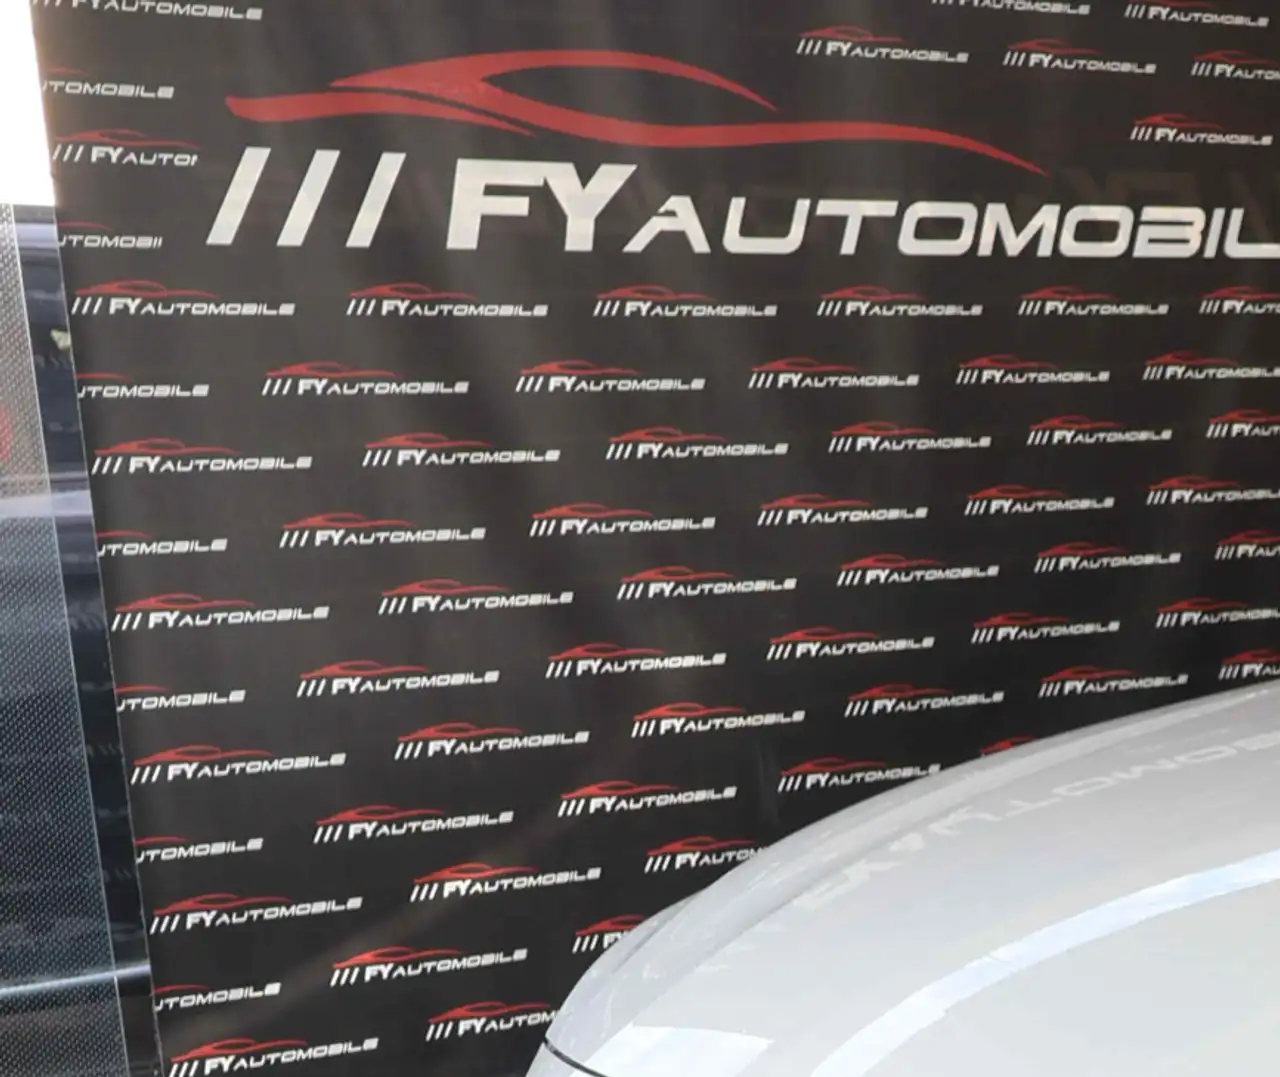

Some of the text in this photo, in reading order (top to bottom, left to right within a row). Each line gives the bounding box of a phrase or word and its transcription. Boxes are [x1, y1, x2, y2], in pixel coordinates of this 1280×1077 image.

[1147, 6, 1269, 27] FYAUTOMOBILE
[825, 41, 969, 63] FYAUTOMOBILE
[1028, 53, 1156, 74] FYAUTOMOBILE
[109, 297, 295, 315] FYAUTOMOBILE
[381, 300, 548, 317] FYAUTOMOBILE
[624, 301, 777, 317] FYAUTOMOBILE
[845, 301, 983, 316] FYAUTOMOBILE
[1044, 297, 1169, 315] FYAUTOMOBILE
[297, 378, 469, 395] FYAUTOMOBILE
[548, 376, 705, 392] FYAUTOMOBILE
[777, 373, 920, 389] FYAUTOMOBILE
[981, 369, 1110, 384] FYAUTOMOBILE
[856, 436, 991, 452] FYAUTOMOBILE
[1052, 429, 1172, 445] FYAUTOMOBILE
[397, 449, 561, 466] FYAUTOMOBILE
[636, 442, 789, 459] FYAUTOMOBILE
[129, 456, 312, 474] FYAUTOMOBILE
[786, 507, 928, 525] FYAUTOMOBILE
[989, 497, 1115, 514] FYAUTOMOBILE
[560, 517, 716, 535] FYAUTOMOBILE
[315, 527, 486, 547] FYAUTOMOBILE
[1058, 552, 1182, 571] FYAUTOMOBILE
[864, 565, 1000, 585] FYAUTOMOBILE
[648, 578, 797, 599] FYAUTOMOBILE
[412, 591, 574, 613] FYAUTOMOBILE
[148, 606, 330, 629] FYAUTOMOBILE
[996, 620, 1120, 642] FYAUTOMOBILE
[795, 636, 935, 658] FYAUTOMOBILE
[576, 653, 727, 676] FYAUTOMOBILE
[331, 670, 500, 695] FYAUTOMOBILE
[1063, 674, 1188, 695] FYAUTOMOBILE
[872, 691, 1004, 714] FYAUTOMOBILE
[659, 710, 805, 735] FYAUTOMOBILE
[427, 731, 590, 757] FYAUTOMOBILE
[167, 752, 346, 782] FYAUTOMOBILE
[589, 786, 737, 814] FYAUTOMOBILE
[348, 811, 514, 840] FYAUTOMOBILE
[442, 864, 601, 899] FYAUTOMOBILE
[186, 896, 363, 930] FYAUTOMOBILE
[364, 948, 528, 983] FYAUTOMOBILE
[203, 1037, 380, 1077] FYAUTOMOBILE
